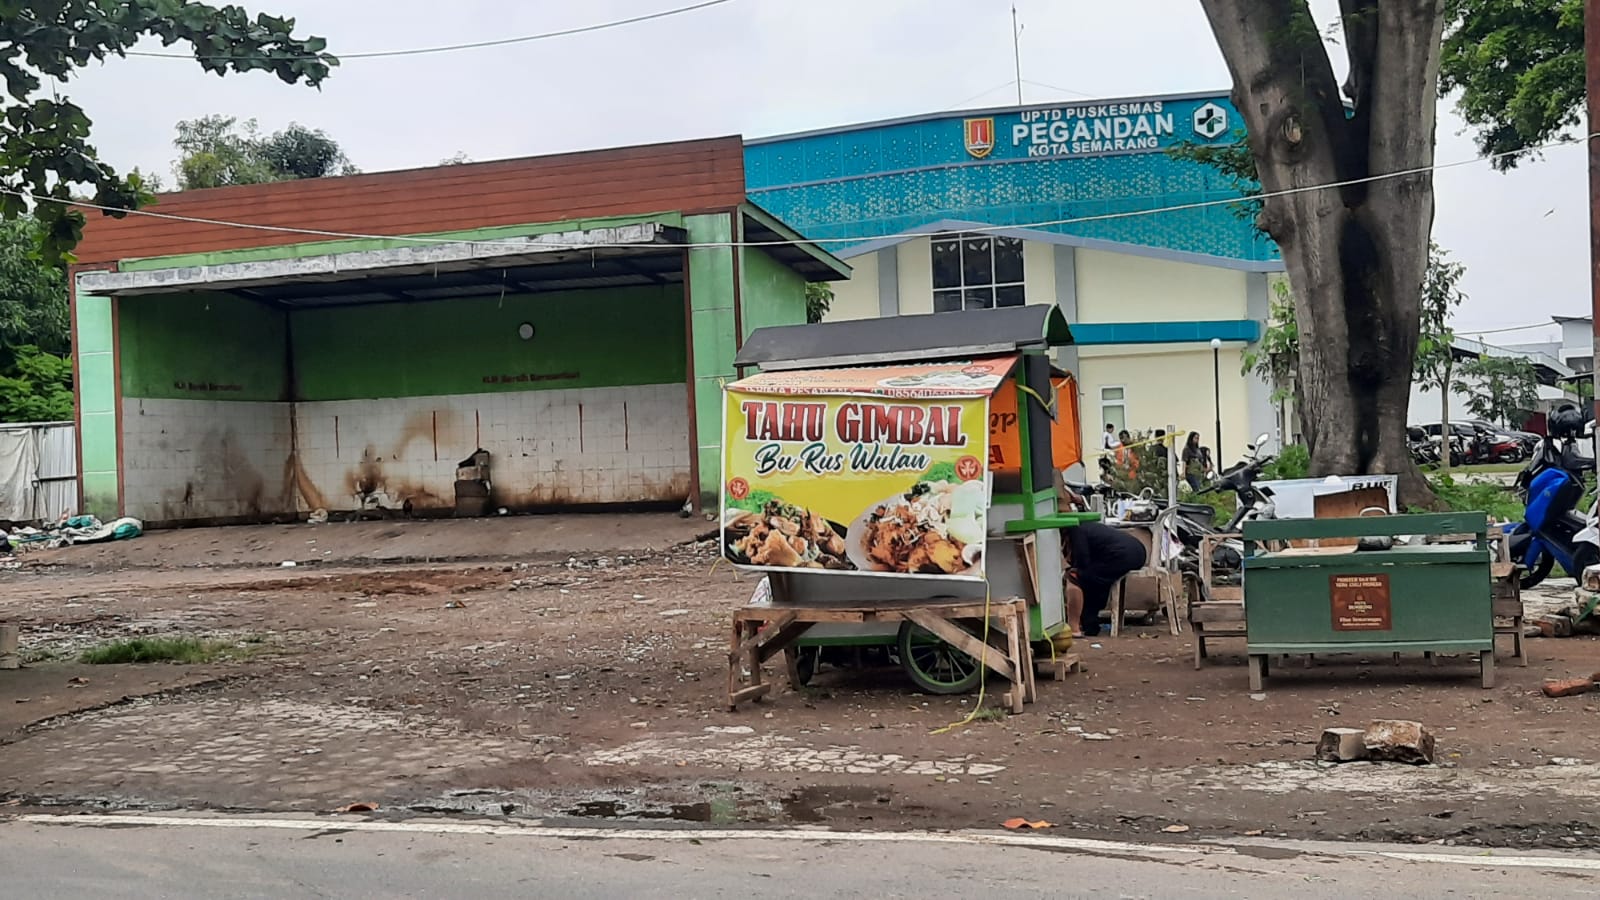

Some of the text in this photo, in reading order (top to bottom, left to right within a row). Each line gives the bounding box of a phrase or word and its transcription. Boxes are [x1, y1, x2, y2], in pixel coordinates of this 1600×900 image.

[1021, 101, 1164, 123] UPTD PUSKESMAS
[1012, 113, 1174, 147] PEGANDAN
[1028, 135, 1159, 158] KOTA SEMARANG
[742, 401, 967, 447] TAHU GIMBAL
[755, 442, 930, 474] Bu Rus Wulan
